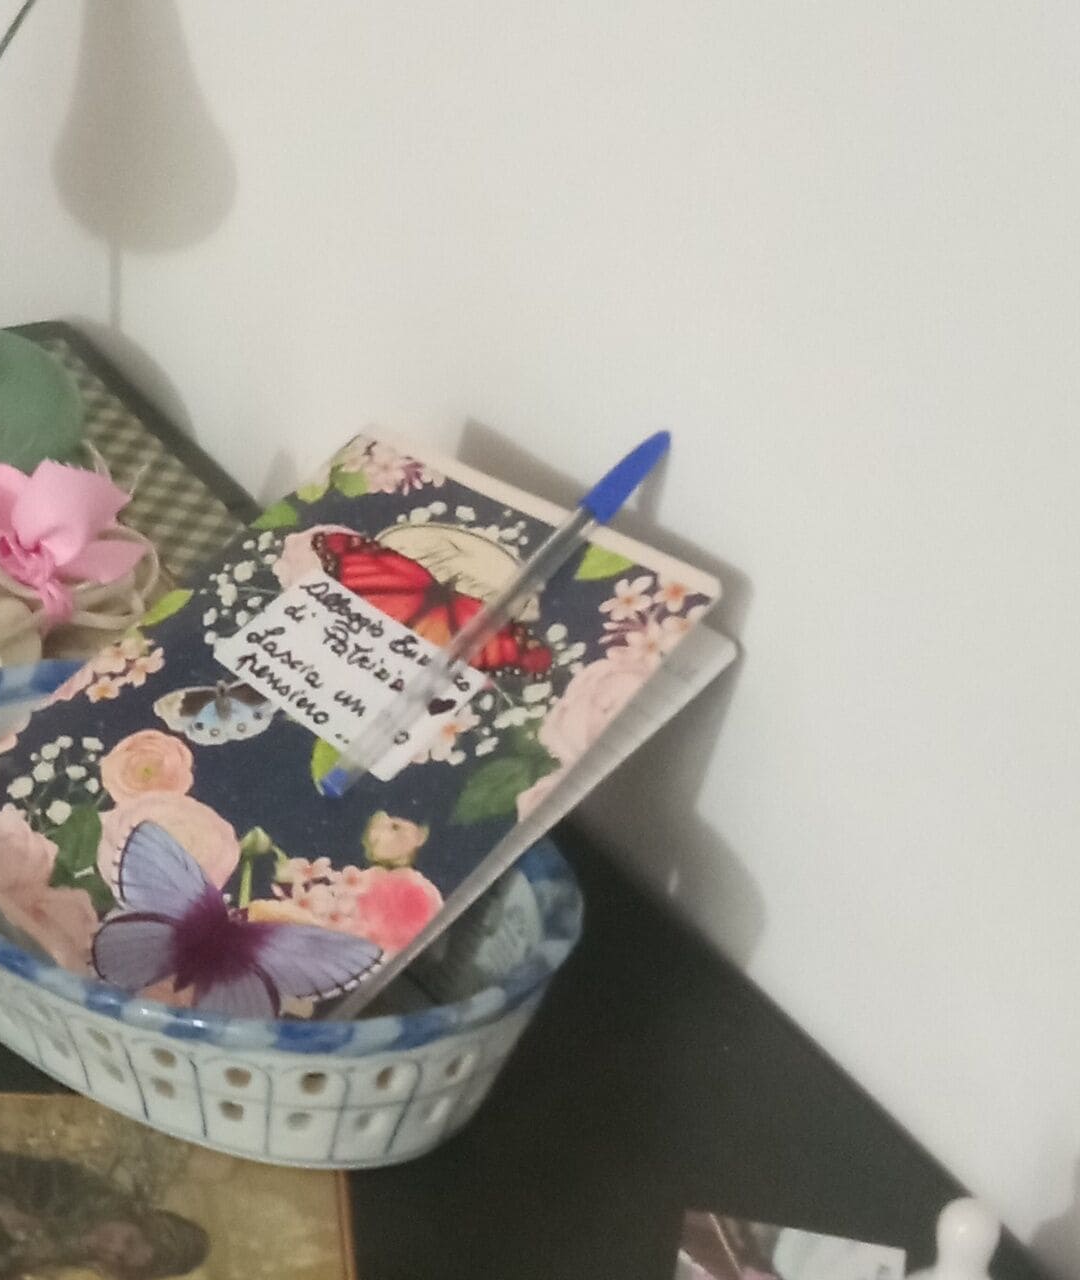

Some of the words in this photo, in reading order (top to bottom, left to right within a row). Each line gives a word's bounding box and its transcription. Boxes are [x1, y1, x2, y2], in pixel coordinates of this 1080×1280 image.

[246, 625, 324, 689] Lascia
[333, 689, 367, 718] un
[323, 619, 406, 693] Patrizia
